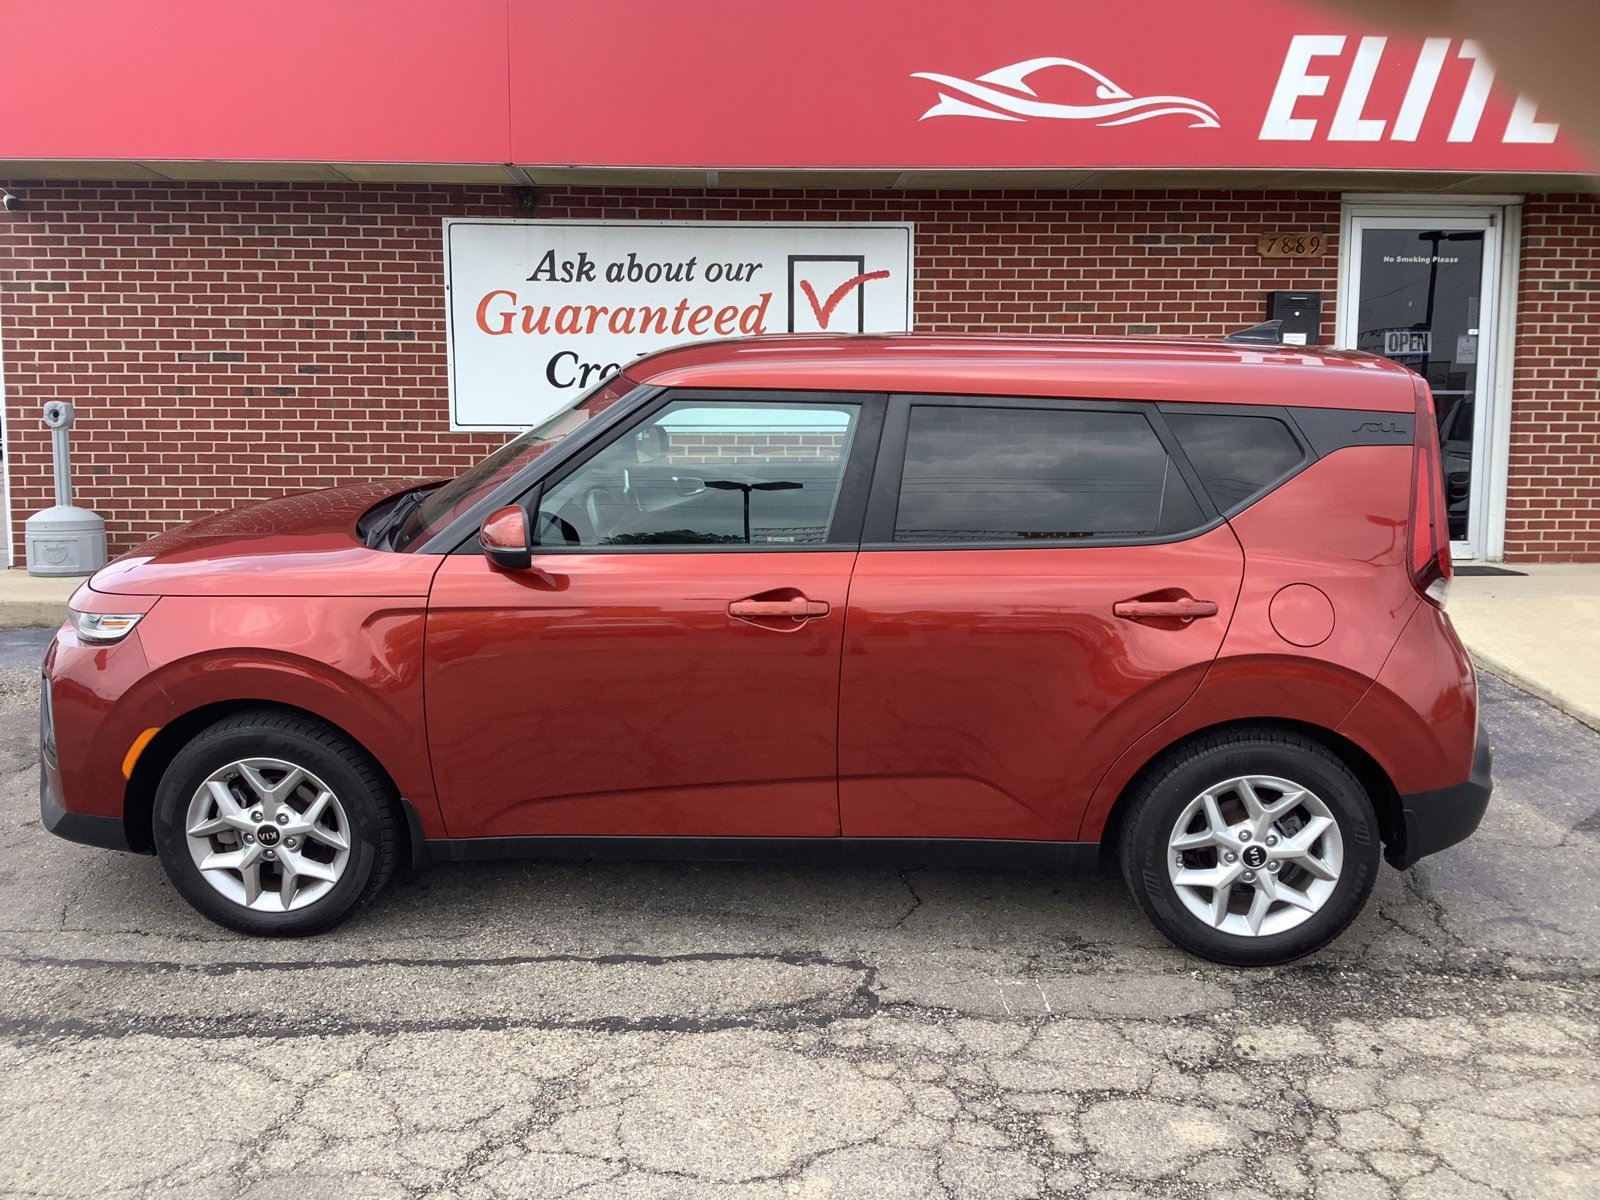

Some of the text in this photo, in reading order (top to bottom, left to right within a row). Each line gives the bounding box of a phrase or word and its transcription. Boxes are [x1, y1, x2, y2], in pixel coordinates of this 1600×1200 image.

[1265, 237, 1320, 254] 7889
[526, 249, 763, 283] Ask about our
[1383, 255, 1395, 263] No
[1396, 255, 1430, 264] Smoking
[475, 289, 773, 336] Guaranteed
[1388, 332, 1428, 352] OPEN
[1352, 422, 1406, 433] SOUL
[258, 830, 278, 841] KIA
[1249, 847, 1261, 867] KIA
